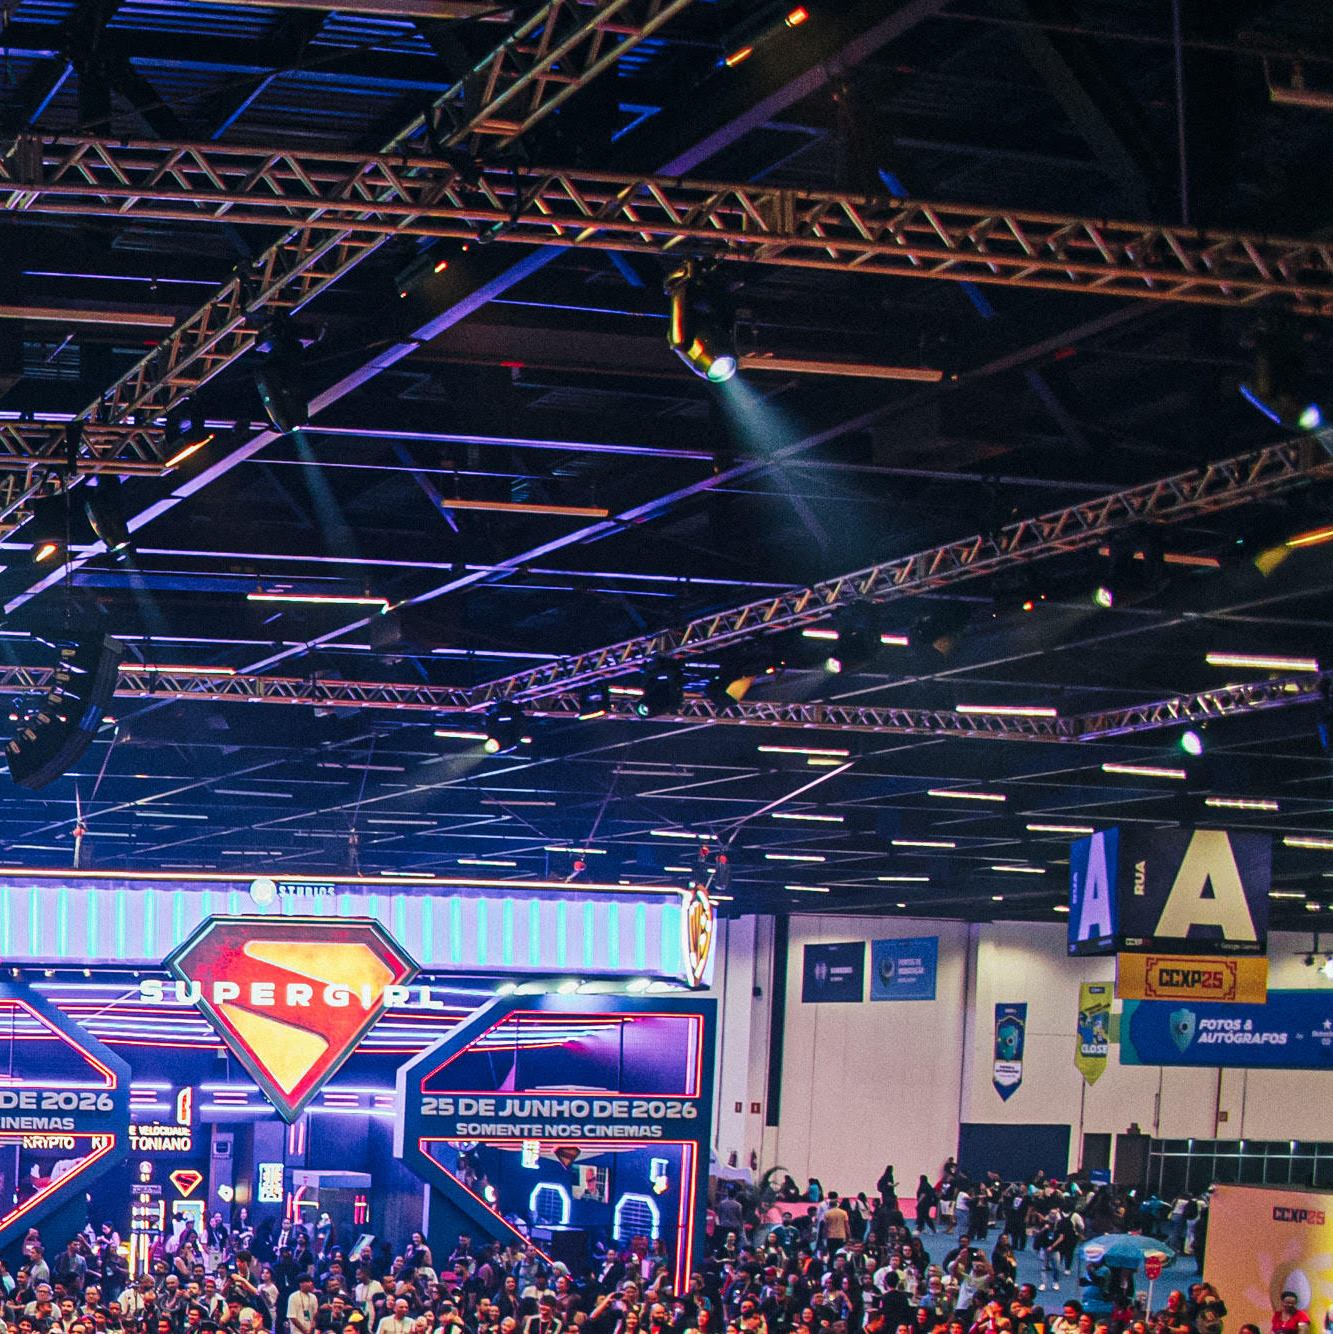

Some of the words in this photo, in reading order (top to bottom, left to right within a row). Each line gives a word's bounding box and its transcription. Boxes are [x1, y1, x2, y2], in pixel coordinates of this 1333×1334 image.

[1134, 860, 1147, 896] RUA
[1154, 830, 1258, 941] A
[278, 885, 335, 897] STUDIOS
[1158, 968, 1224, 989] CCXP25
[138, 979, 445, 1011] SUPERGIRL
[1198, 1018, 1242, 1031] FOTOS
[1197, 1029, 1288, 1046] AUTÓGRAFOS
[41, 1091, 115, 1112] 2026
[420, 1098, 455, 1117] 25
[458, 1098, 495, 1117] DE
[498, 1099, 590, 1118] JUNHO
[593, 1100, 629, 1119] DE
[631, 1100, 698, 1119] 2026
[455, 1122, 543, 1136] SOMENTE
[545, 1124, 582, 1137] NOS
[583, 1124, 663, 1138] CINEMAS
[22, 1136, 75, 1150] KRYPTO
[1272, 1206, 1326, 1226] CCXP25
